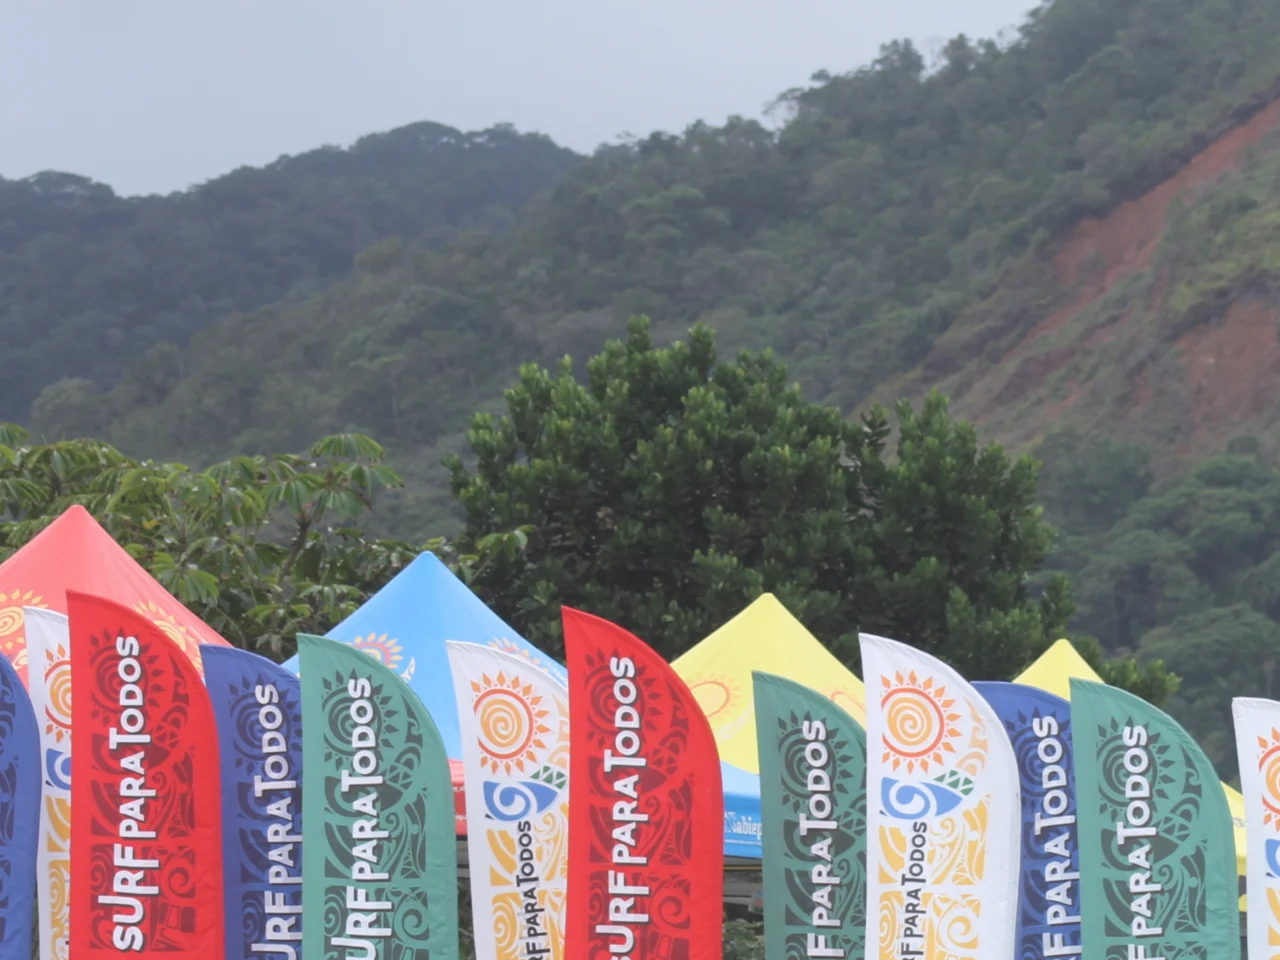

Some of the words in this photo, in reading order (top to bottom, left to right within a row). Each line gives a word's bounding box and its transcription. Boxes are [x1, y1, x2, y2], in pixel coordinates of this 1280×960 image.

[109, 635, 151, 750] TODOS
[341, 677, 384, 792] TODOS
[603, 656, 646, 772] TODOS
[254, 683, 296, 797] TODOS
[799, 719, 838, 836] TODOS
[1033, 714, 1075, 838] TODOS
[1116, 724, 1157, 845] TODOS
[119, 752, 156, 838] PARA
[266, 797, 302, 884] PARA
[351, 792, 389, 880] PARA
[612, 774, 649, 865] PARA
[98, 843, 159, 951] SURF
[516, 820, 535, 888] TODOS
[810, 836, 841, 927] PARA
[901, 821, 927, 889] TODOS
[1044, 832, 1081, 926] PARA
[1127, 844, 1163, 937] PARA
[525, 888, 547, 938] PARA
[903, 889, 925, 940] PARA
